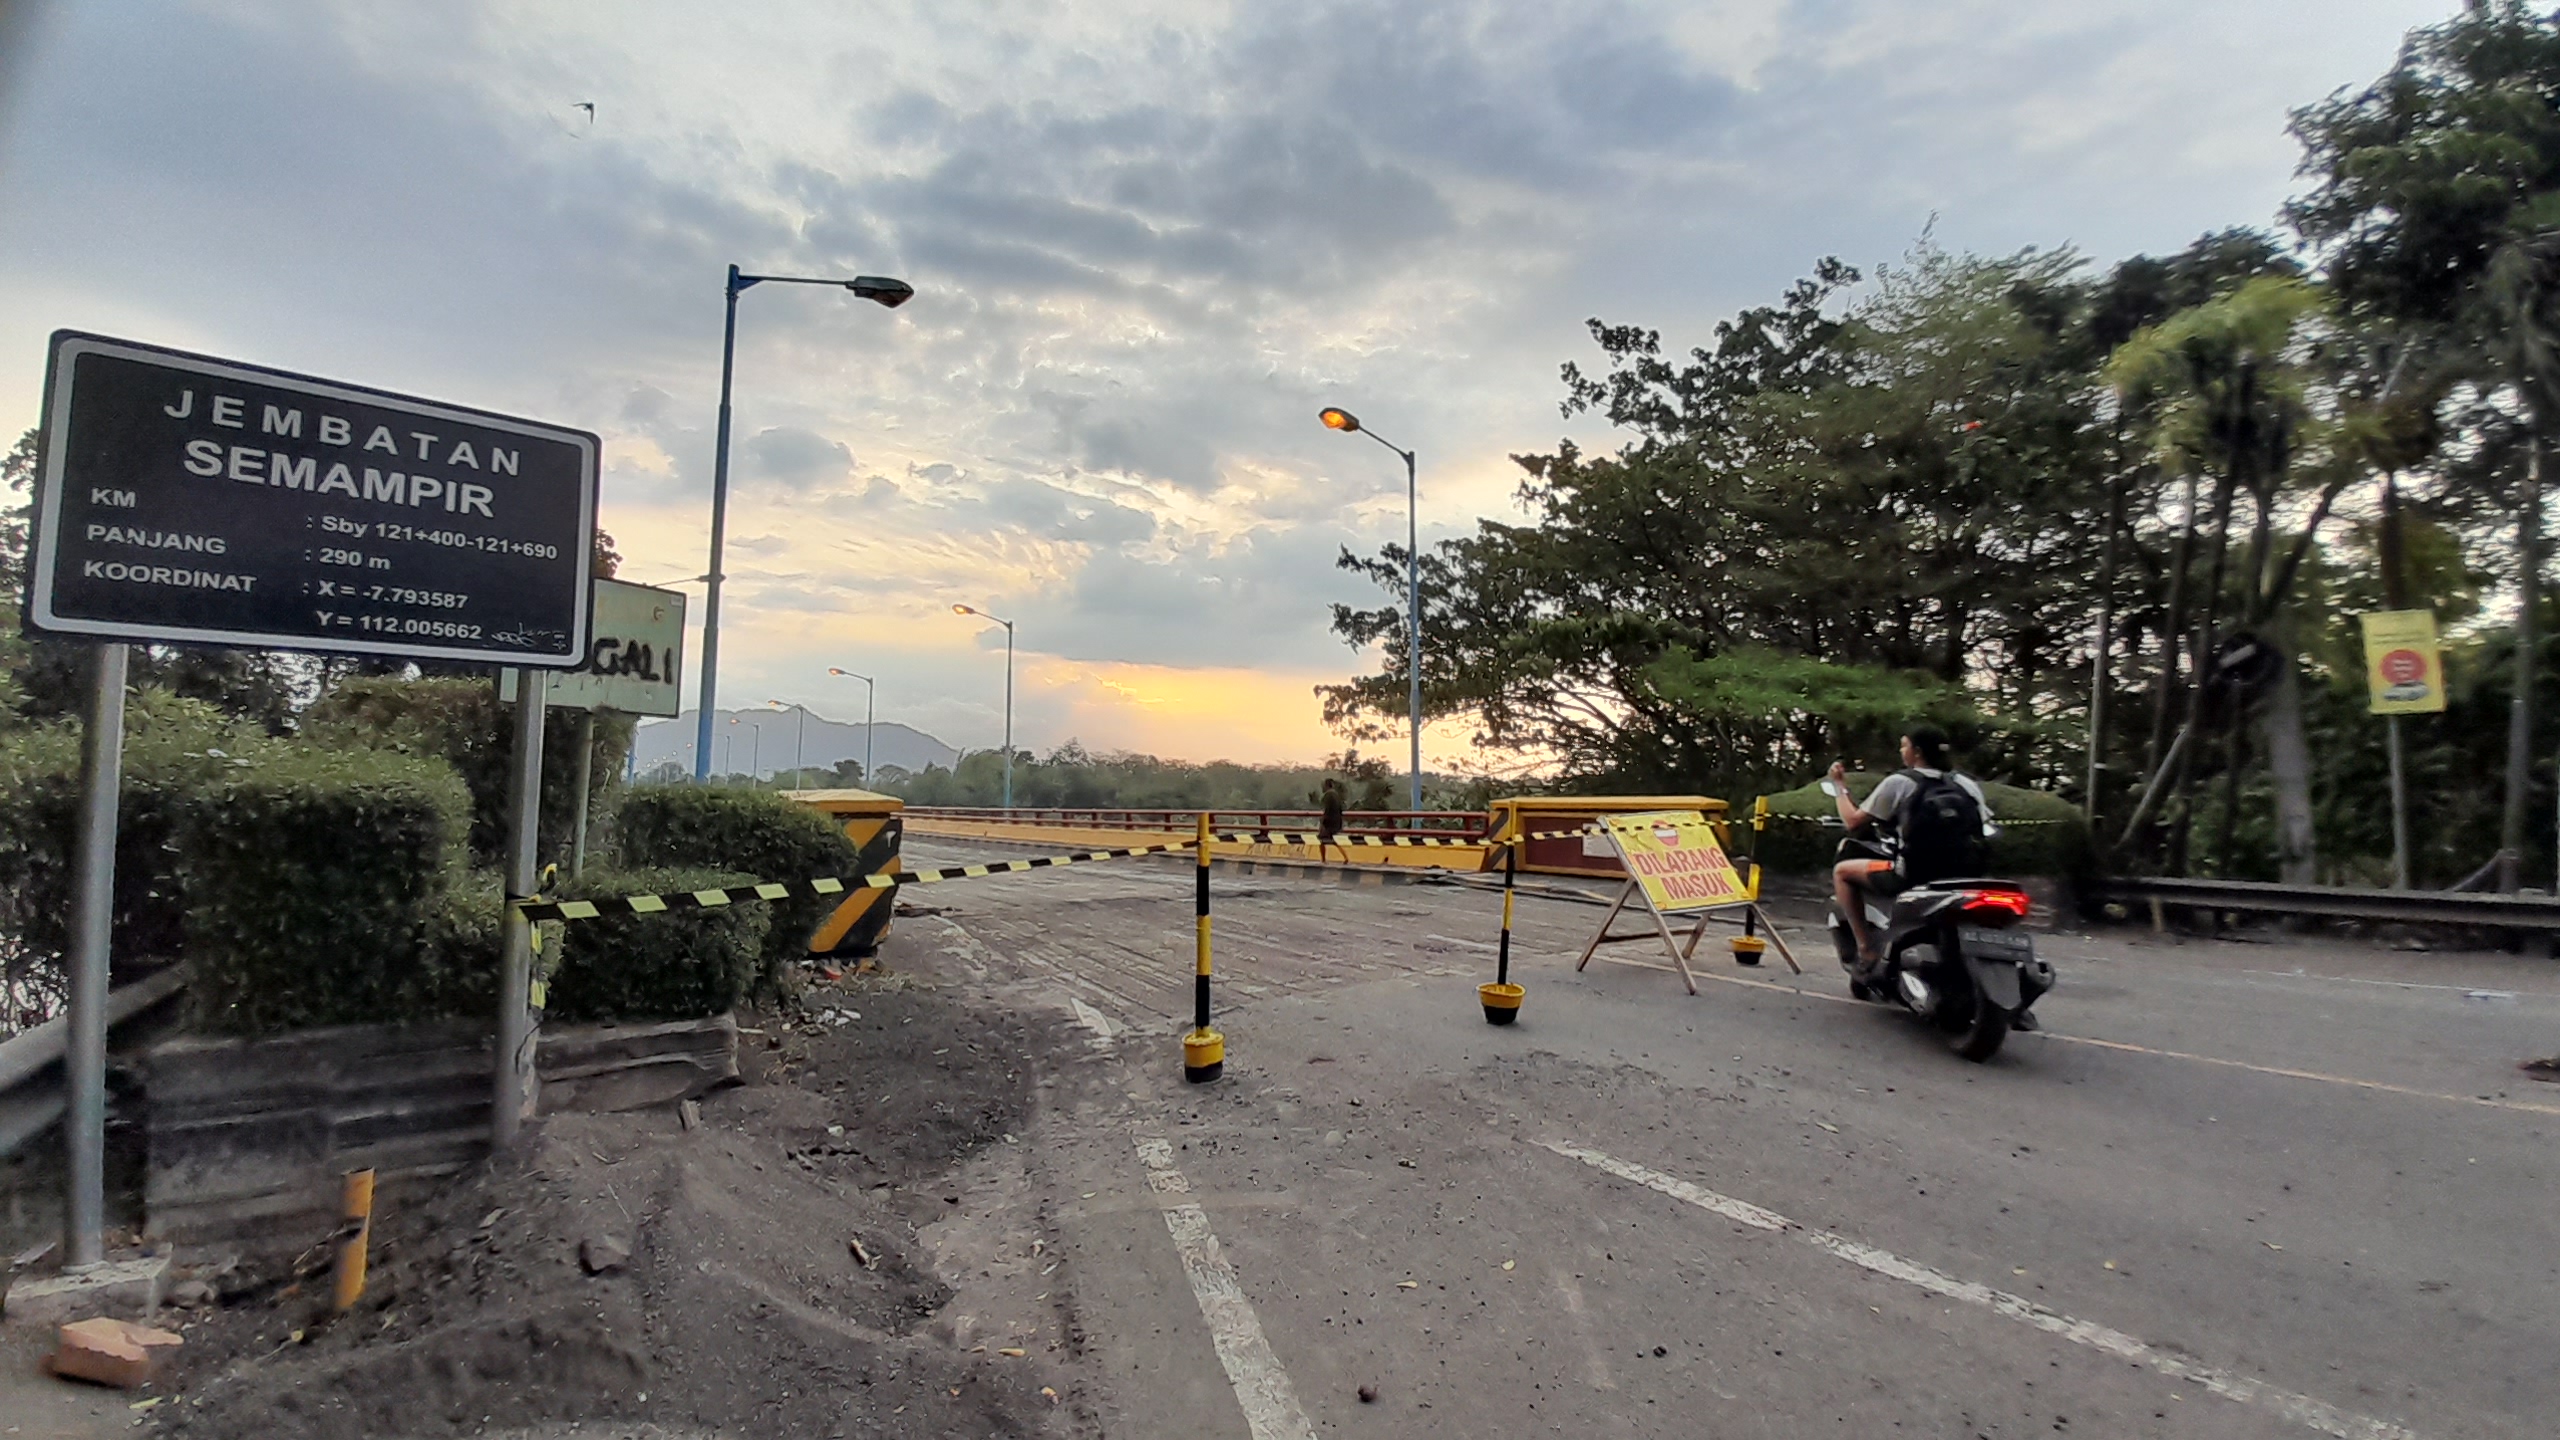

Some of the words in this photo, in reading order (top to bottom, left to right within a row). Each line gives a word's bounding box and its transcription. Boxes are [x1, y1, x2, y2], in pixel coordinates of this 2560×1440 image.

[164, 389, 520, 477] JEMBATAN
[183, 439, 495, 518] SEMAMPIR
[87, 524, 227, 555] PANJANG
[319, 547, 363, 567] 290
[368, 556, 391, 570] m
[90, 487, 137, 509] KM
[321, 515, 368, 538] Sby
[375, 522, 558, 560] 121+400-121+690
[84, 560, 258, 593] KOORDINAT
[317, 580, 336, 597] X
[362, 585, 469, 609] -7.793587
[316, 610, 334, 627] Y
[359, 614, 483, 640] 112.005662
[1634, 847, 1729, 876] DILARANG
[1660, 872, 1734, 901] MASUK
